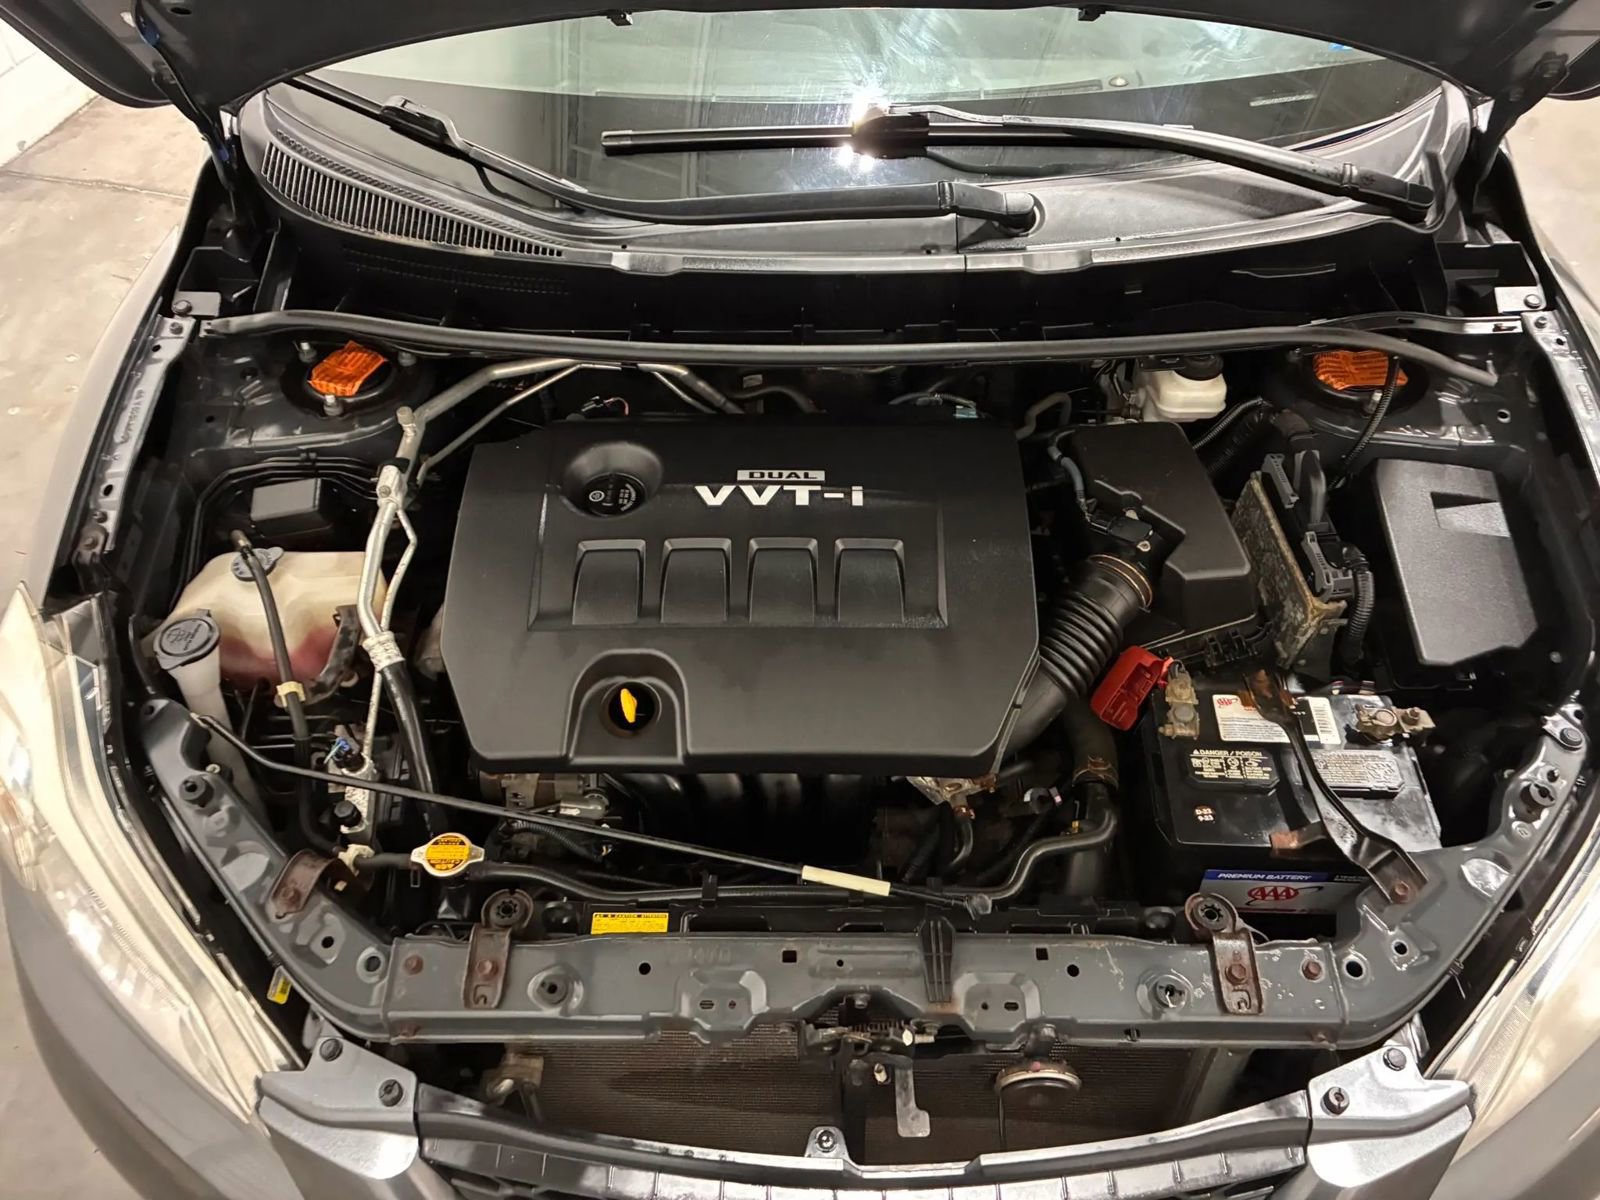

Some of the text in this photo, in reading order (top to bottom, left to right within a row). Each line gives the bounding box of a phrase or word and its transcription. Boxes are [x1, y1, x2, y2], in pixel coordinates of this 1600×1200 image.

[748, 471, 818, 480] DUAL
[694, 484, 864, 507] VVT-i
[1200, 749, 1229, 757] DANGER
[1250, 886, 1297, 901] AAA
